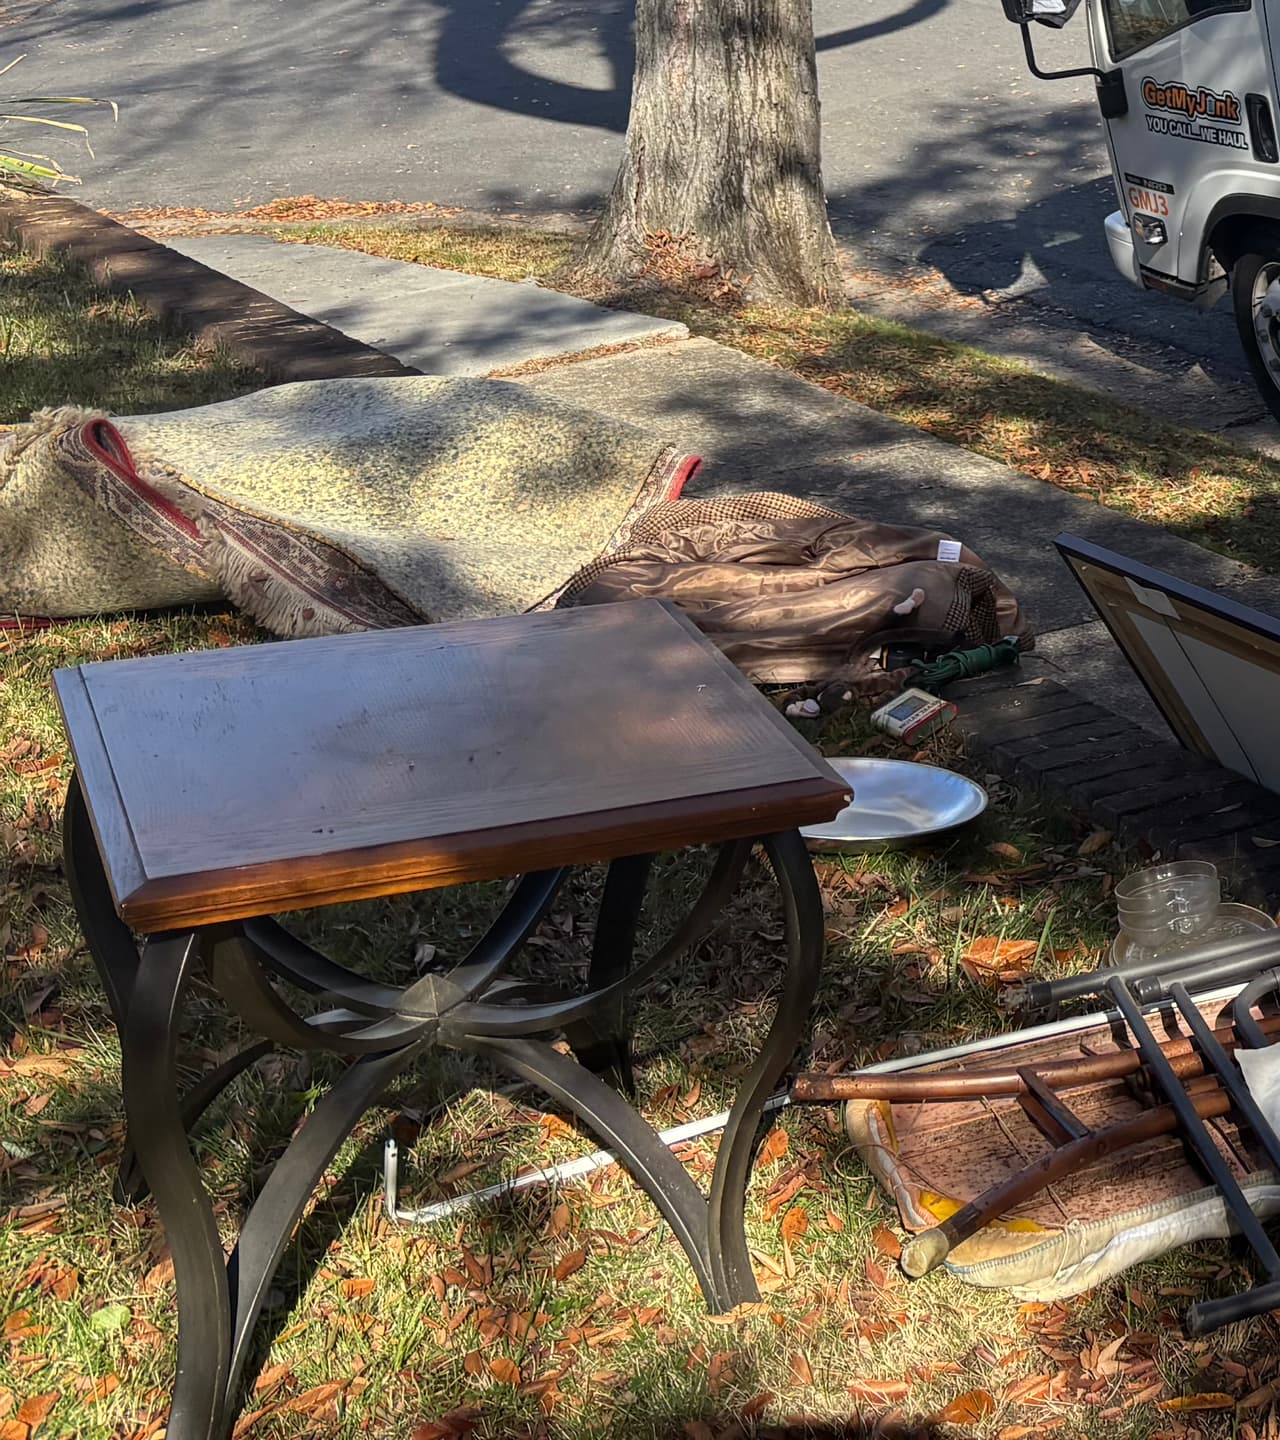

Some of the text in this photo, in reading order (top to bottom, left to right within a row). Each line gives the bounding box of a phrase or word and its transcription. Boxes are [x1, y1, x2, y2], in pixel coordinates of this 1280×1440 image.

[1146, 117, 1168, 132] YOU
[1218, 131, 1248, 149] HAUL
[1129, 187, 1168, 216] GMJ3
